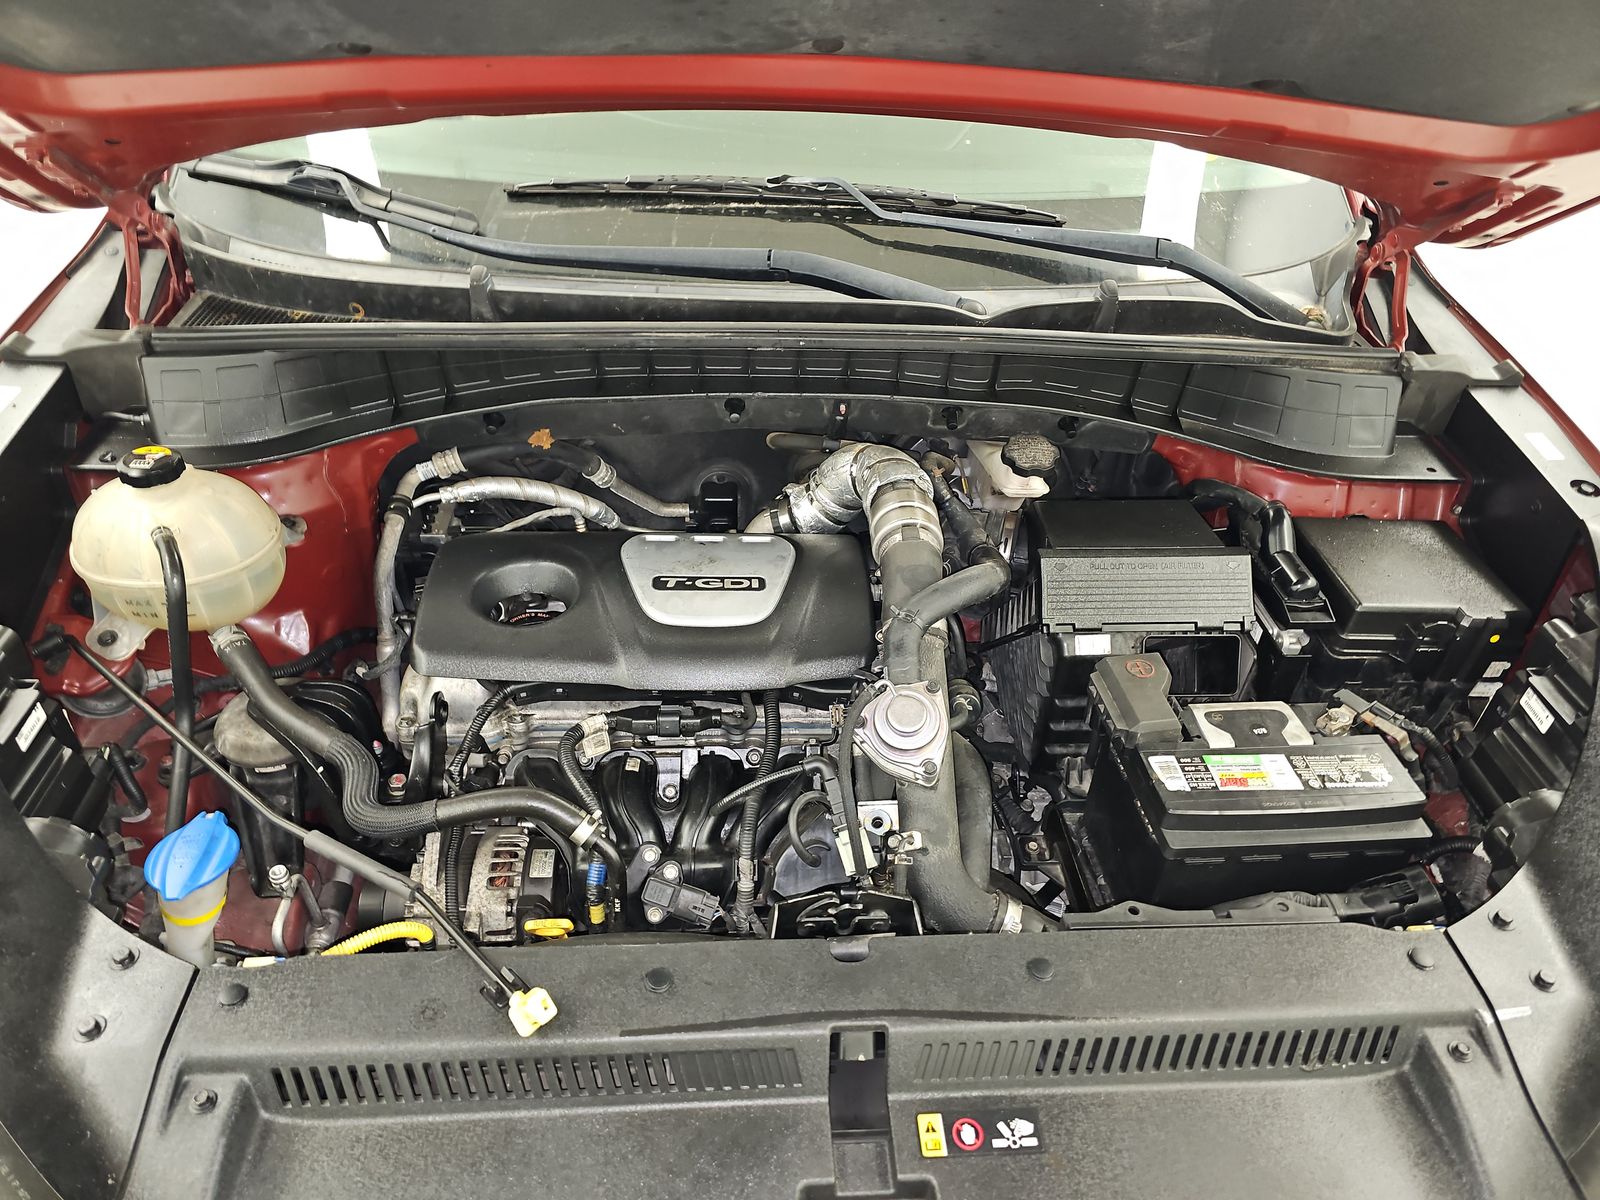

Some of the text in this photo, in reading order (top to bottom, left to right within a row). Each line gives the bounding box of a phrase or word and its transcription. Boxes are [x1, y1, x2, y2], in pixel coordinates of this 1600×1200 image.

[660, 577, 759, 589] T-GDI
[124, 599, 153, 607] MAX
[131, 611, 159, 619] MIN
